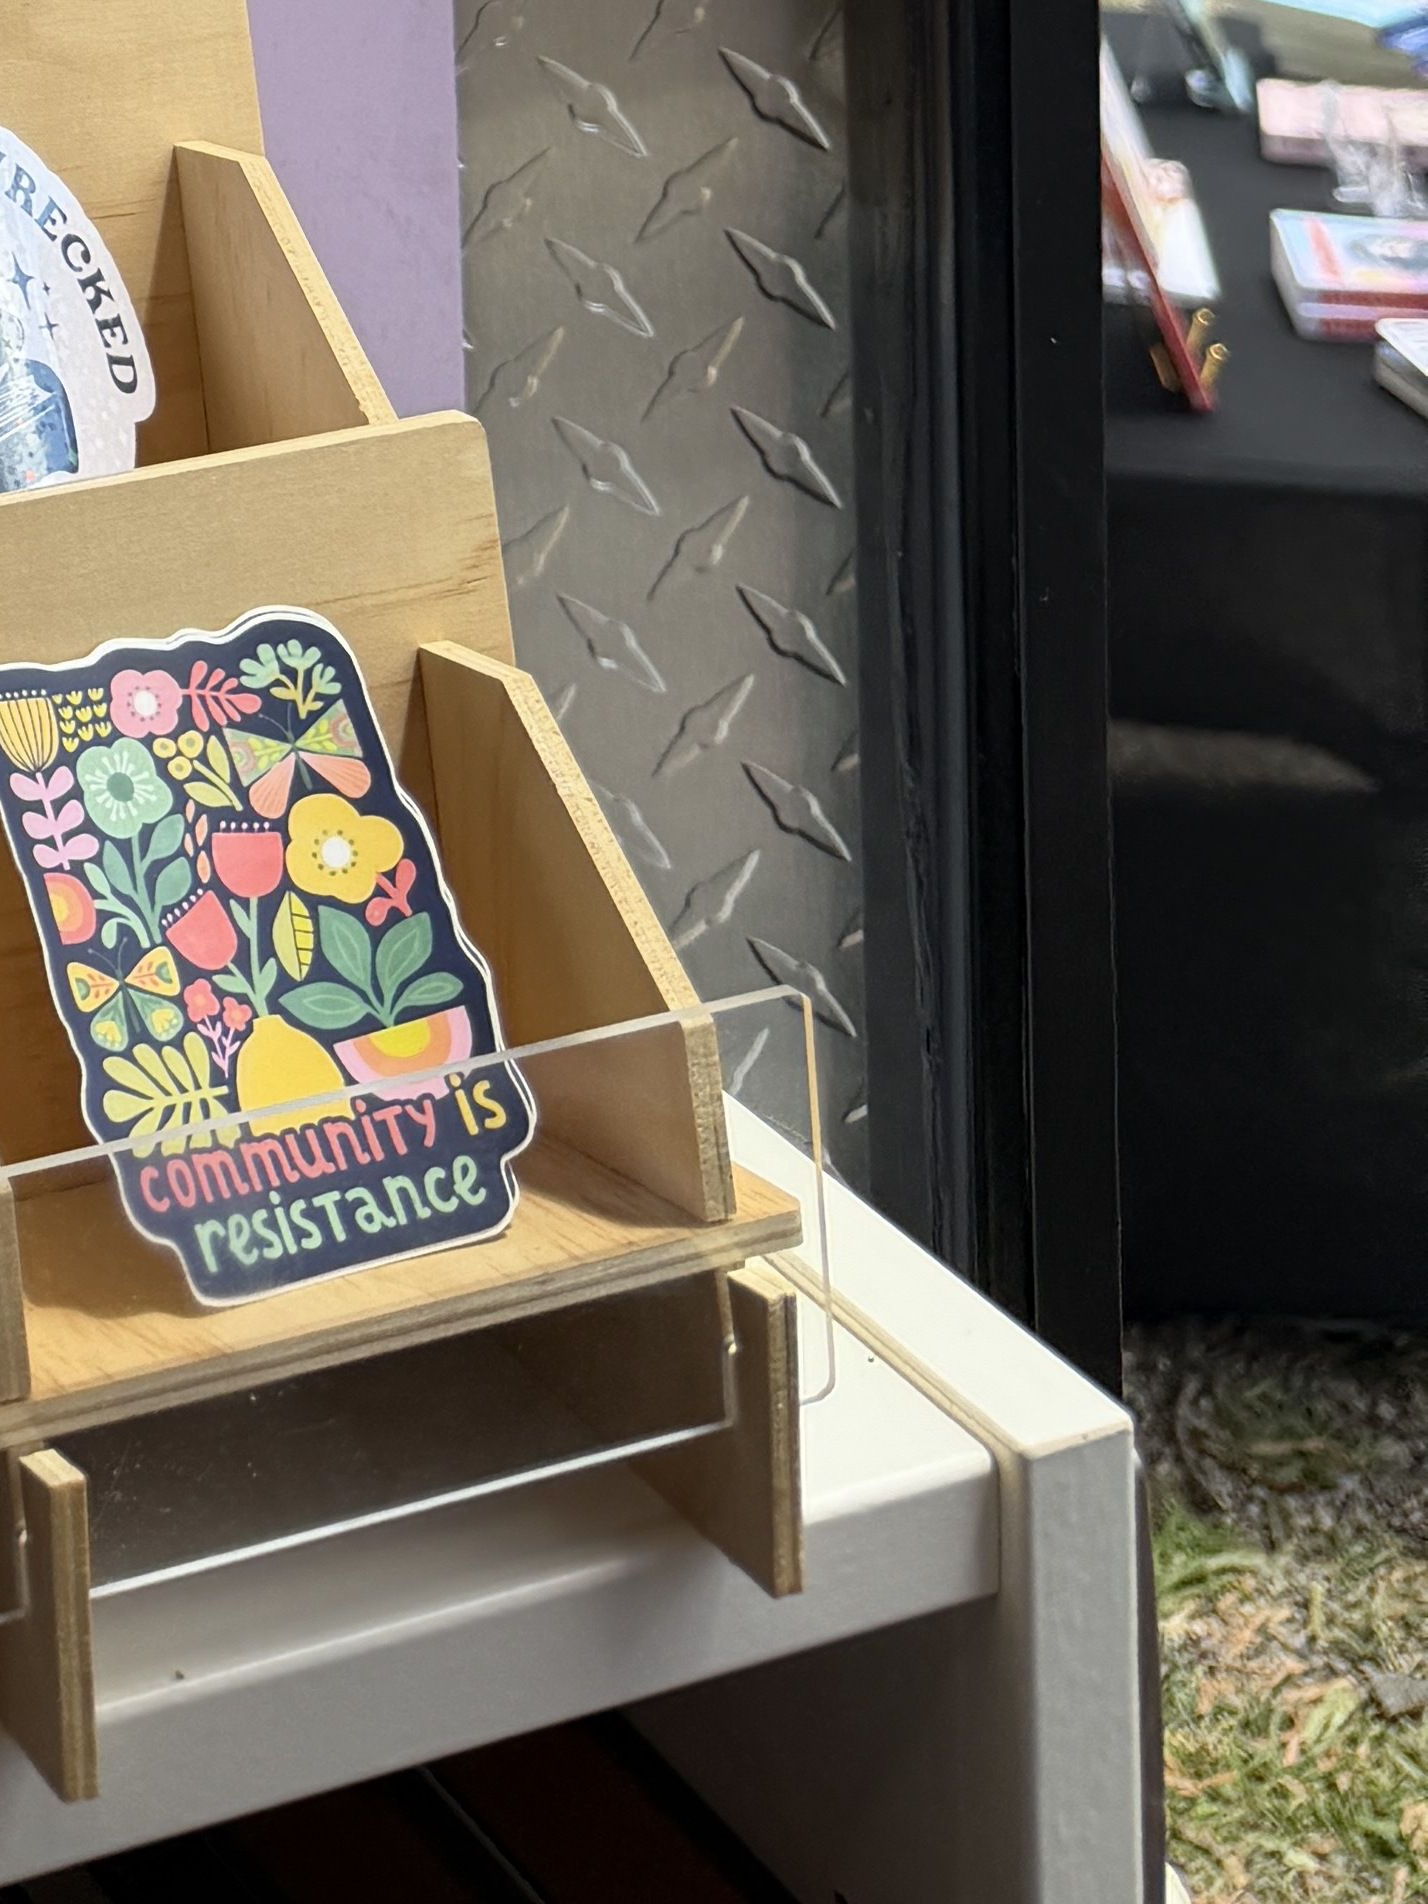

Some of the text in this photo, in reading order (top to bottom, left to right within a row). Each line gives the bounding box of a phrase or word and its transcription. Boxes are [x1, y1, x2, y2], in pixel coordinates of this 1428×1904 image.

[140, 1073, 507, 1214] community is
[194, 1153, 488, 1274] resistance
